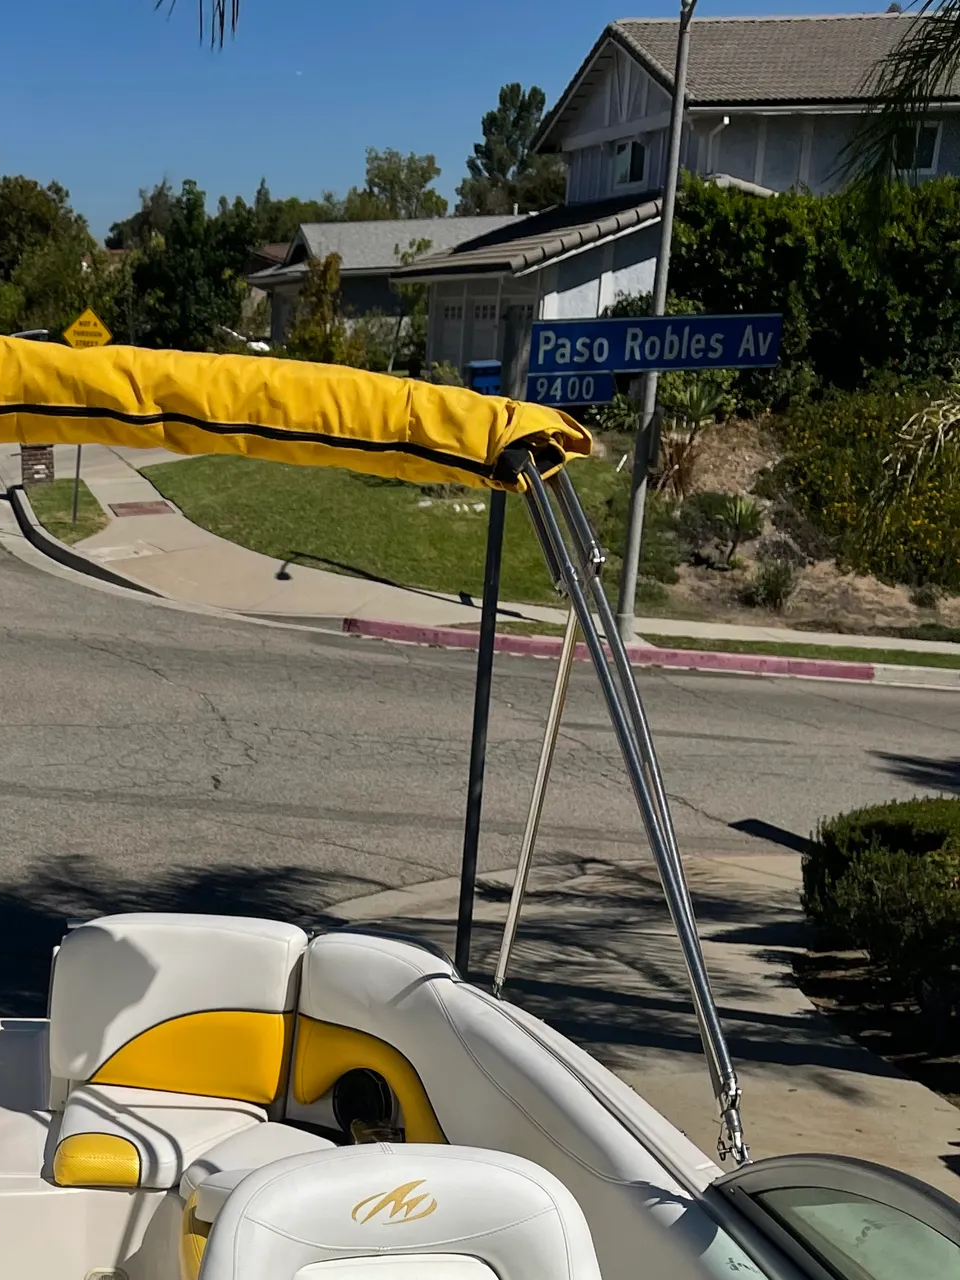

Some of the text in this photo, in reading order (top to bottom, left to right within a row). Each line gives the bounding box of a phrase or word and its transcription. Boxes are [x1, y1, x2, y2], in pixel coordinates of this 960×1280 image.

[537, 324, 774, 365] Paso Robles Av
[535, 376, 595, 401] 9400
